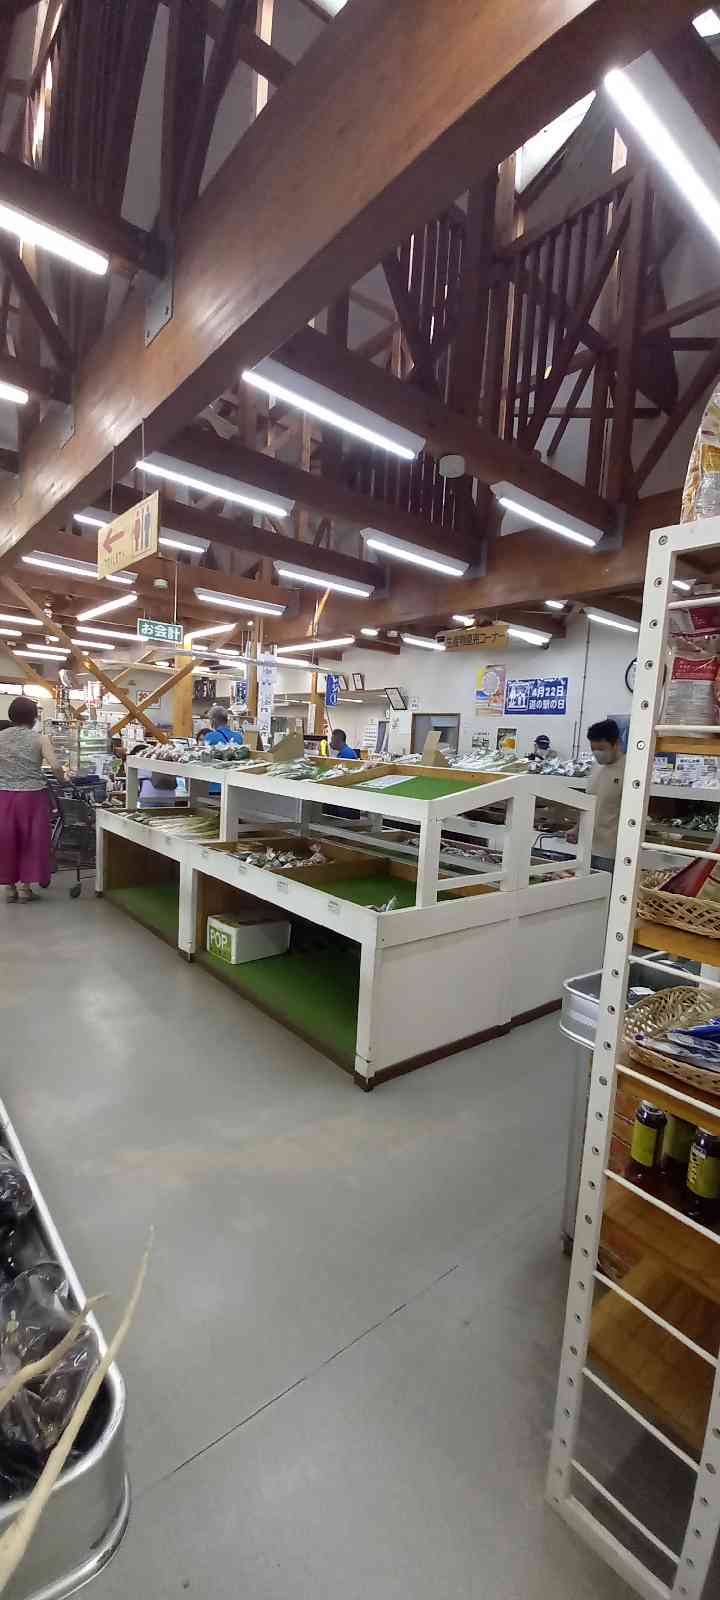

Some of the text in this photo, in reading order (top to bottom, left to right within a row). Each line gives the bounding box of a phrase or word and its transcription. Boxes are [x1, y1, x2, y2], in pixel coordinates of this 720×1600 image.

[141, 622, 181, 641] お会計
[531, 686, 564, 698] 4月22日
[528, 699, 564, 711] 道の駅の日
[210, 927, 228, 949] POP
